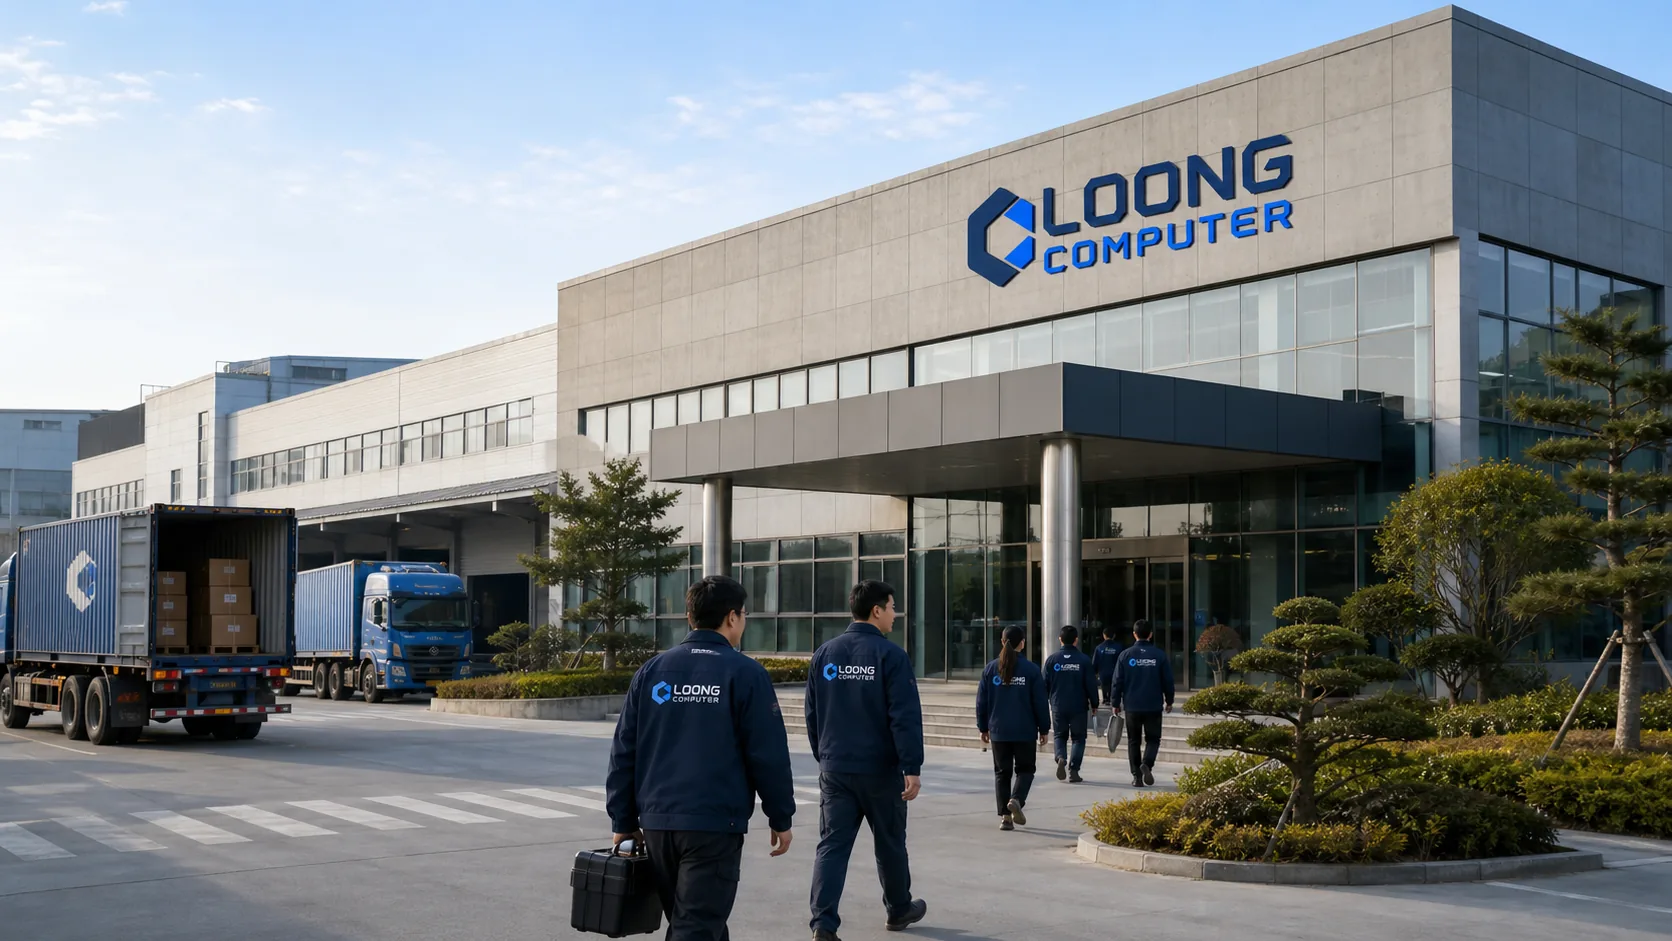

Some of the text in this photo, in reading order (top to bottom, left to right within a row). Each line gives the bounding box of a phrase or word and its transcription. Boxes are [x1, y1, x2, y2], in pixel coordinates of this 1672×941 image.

[1042, 134, 1293, 236] LOONG
[1043, 199, 1294, 275] COMPUTER
[838, 665, 875, 675] LOONG
[673, 684, 721, 696] LOONG
[672, 696, 720, 704] COMPUTER
